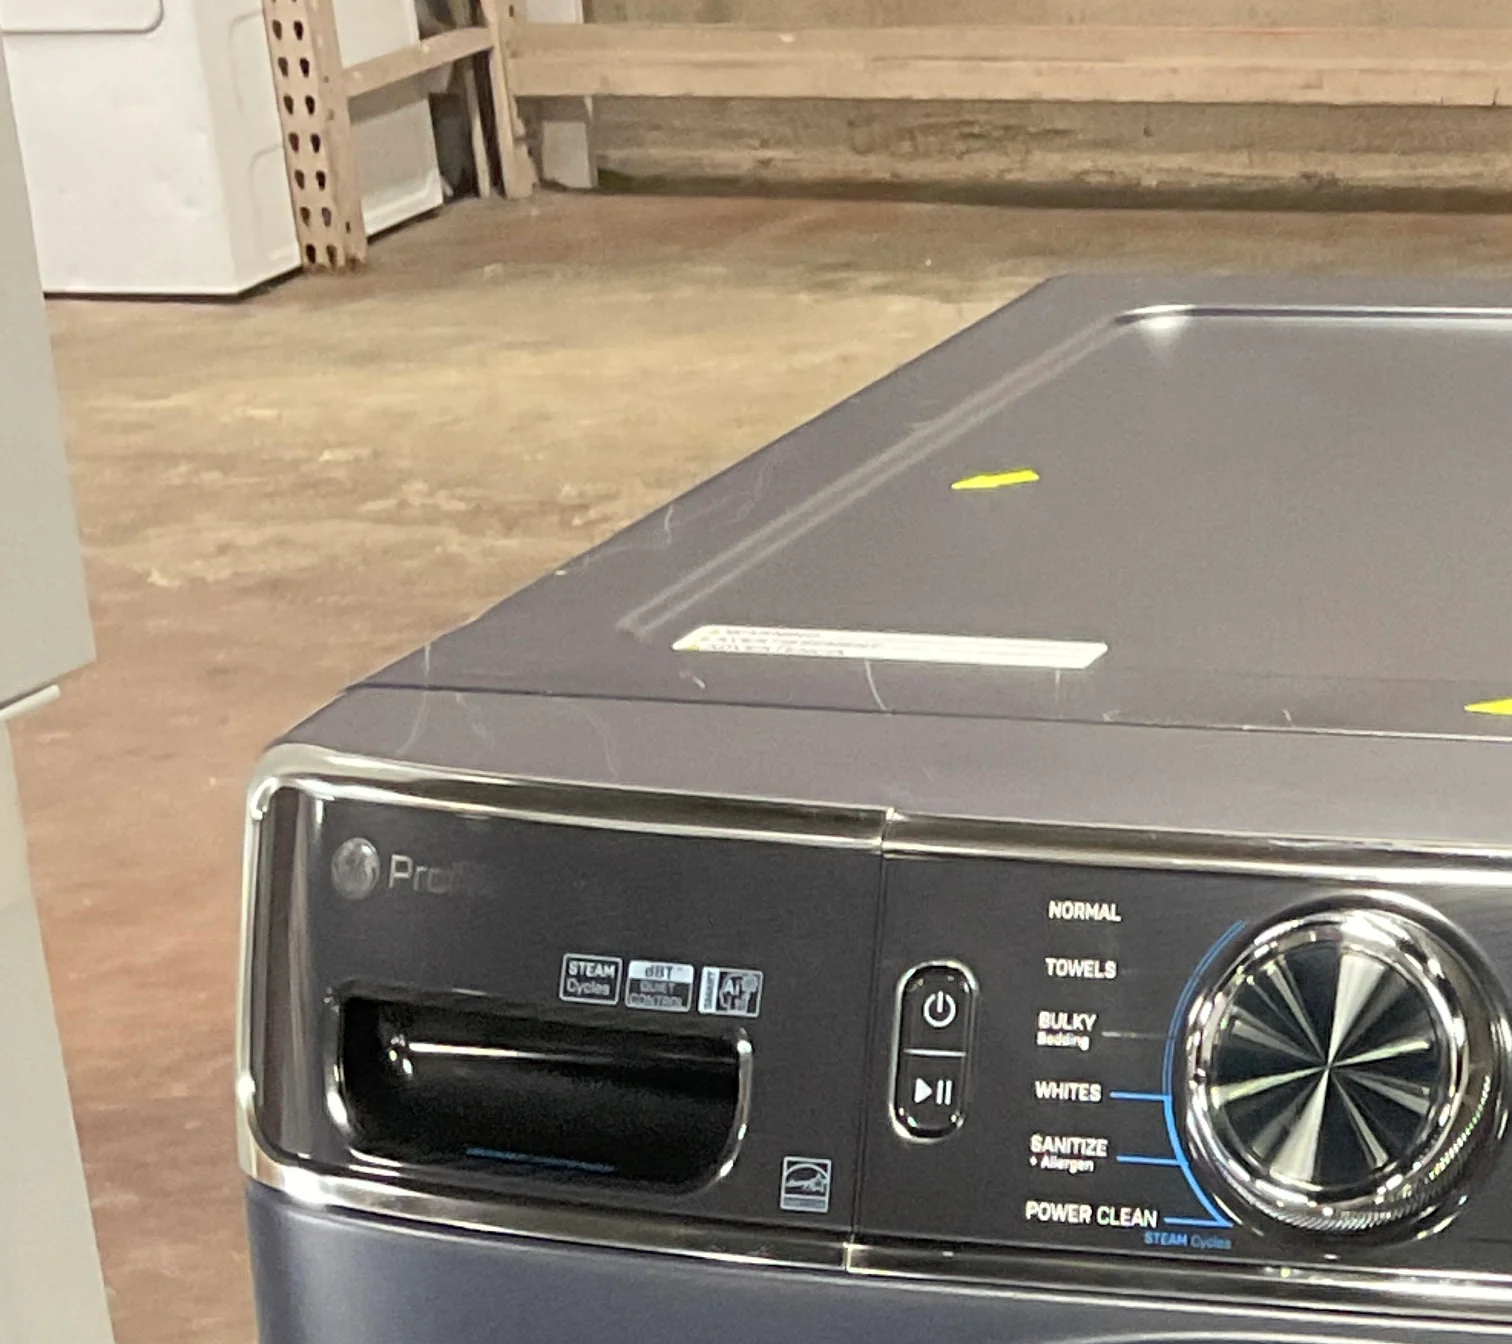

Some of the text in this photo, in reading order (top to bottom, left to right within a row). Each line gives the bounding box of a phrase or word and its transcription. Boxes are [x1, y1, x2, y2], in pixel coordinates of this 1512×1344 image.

[1048, 900, 1122, 922] NORMAL
[568, 960, 616, 979] STEAM
[1045, 957, 1117, 979] TOWELS
[566, 978, 611, 996] Cycles
[1038, 1010, 1097, 1032] BULKY
[1035, 1080, 1102, 1102] WHITES
[1030, 1133, 1108, 1157] SANITIZE
[1040, 1155, 1094, 1174] Allergen
[1025, 1201, 1158, 1228] POWER CLEAN
[1144, 1231, 1232, 1250] STEAM Cycles
